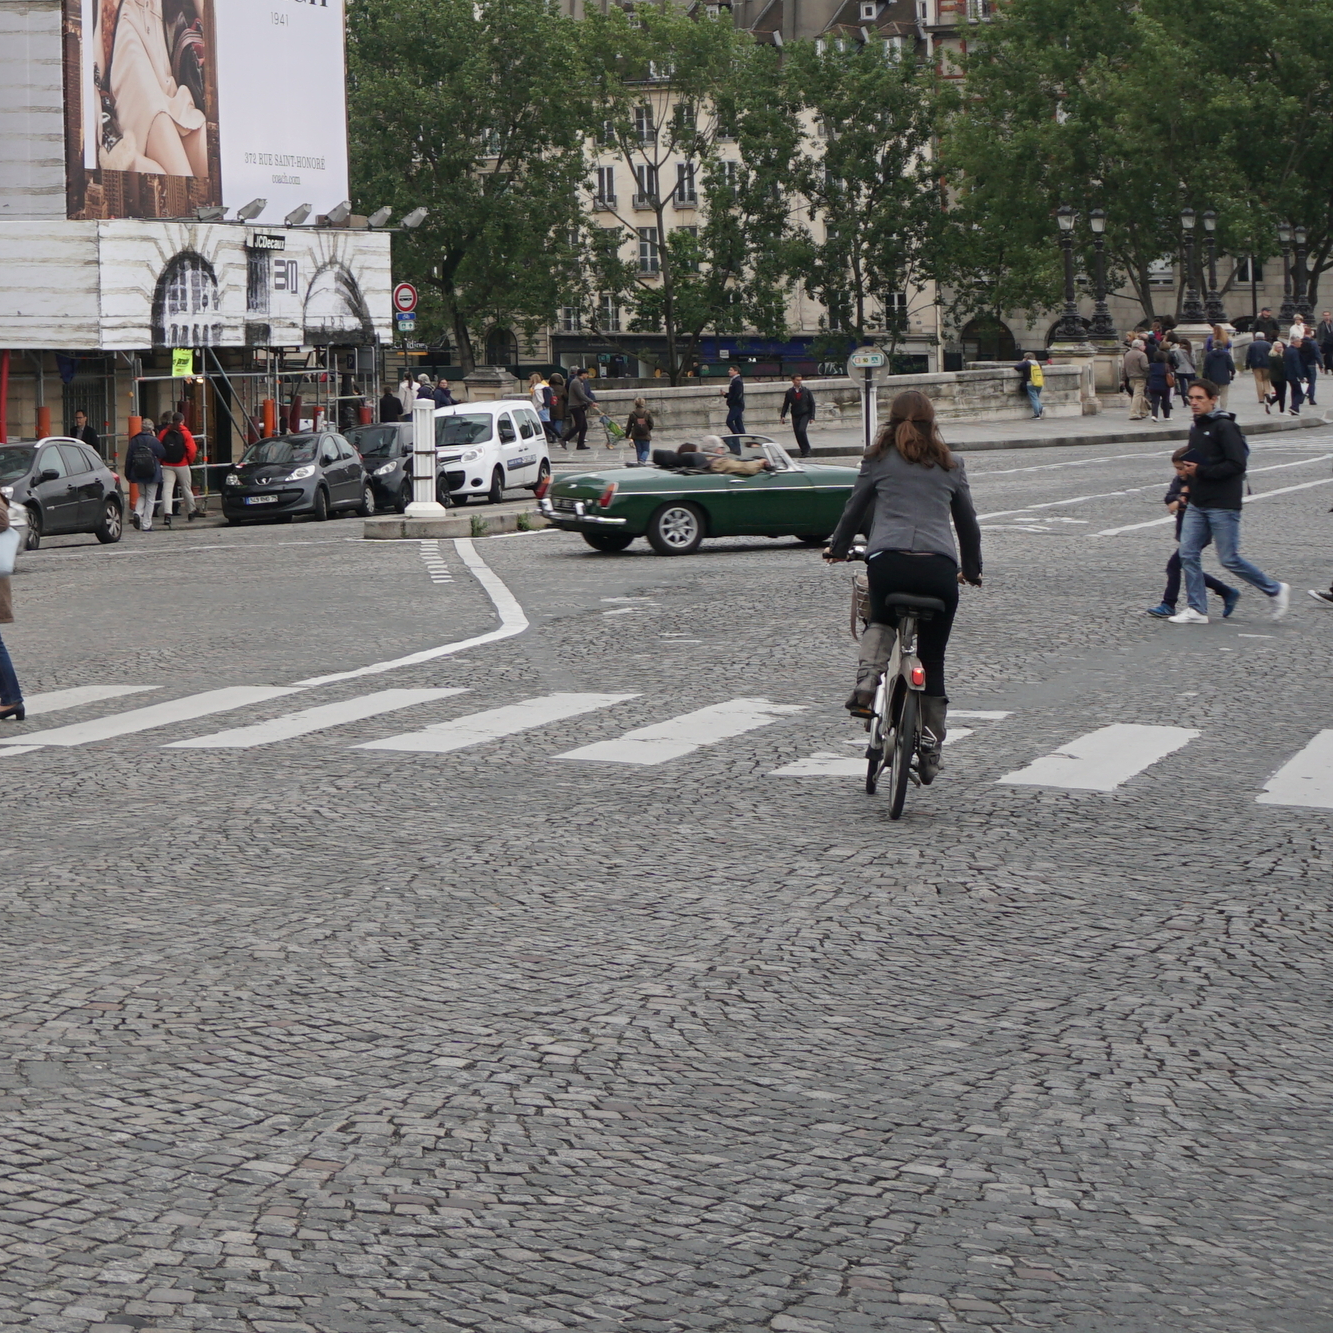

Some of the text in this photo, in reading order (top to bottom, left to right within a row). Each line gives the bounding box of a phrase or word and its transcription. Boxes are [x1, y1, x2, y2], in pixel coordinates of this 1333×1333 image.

[270, 11, 289, 27] 1941
[244, 152, 326, 170] 372 RUE SAINT-HONORÉ
[271, 172, 301, 185] coach.com
[254, 235, 285, 249] JCDecaux
